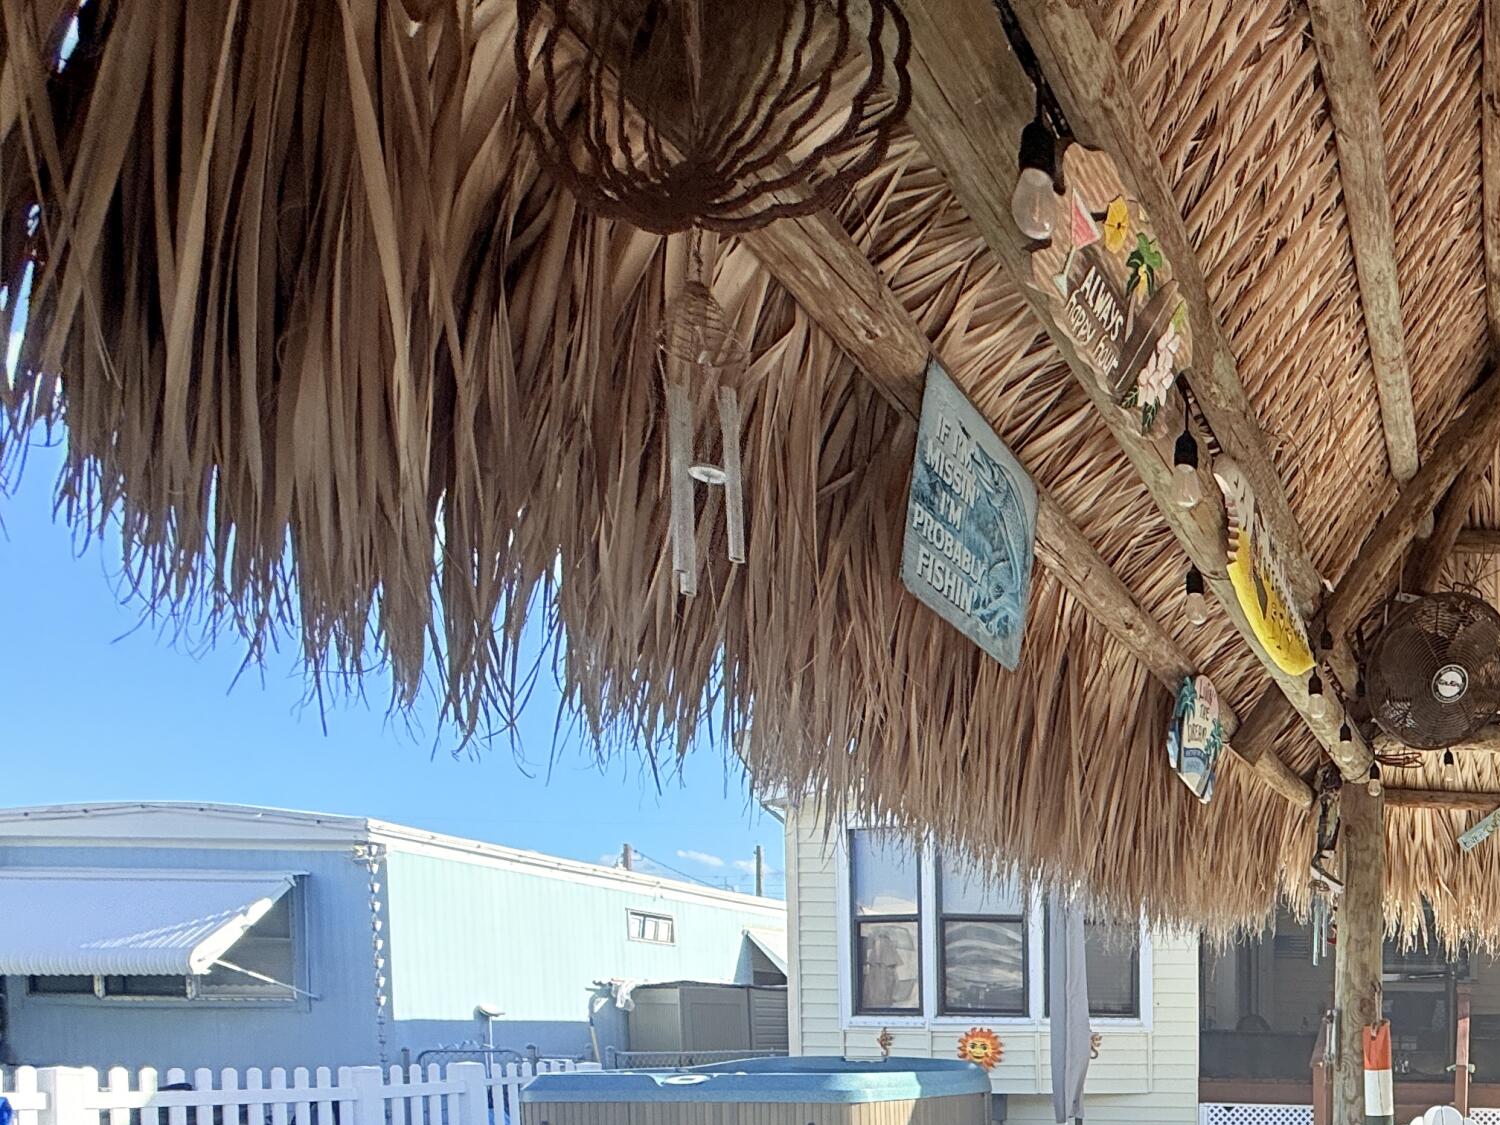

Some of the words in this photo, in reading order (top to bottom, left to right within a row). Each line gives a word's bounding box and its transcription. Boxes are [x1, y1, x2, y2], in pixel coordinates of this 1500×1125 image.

[1064, 289, 1096, 346] happy
[1092, 334, 1119, 376] hour
[1080, 265, 1124, 341] ALWAYS
[925, 438, 979, 509] MISSIN'
[936, 413, 951, 446] IF
[952, 431, 974, 474] I'M
[912, 503, 988, 586] PROBABLY
[938, 491, 963, 532] I'M
